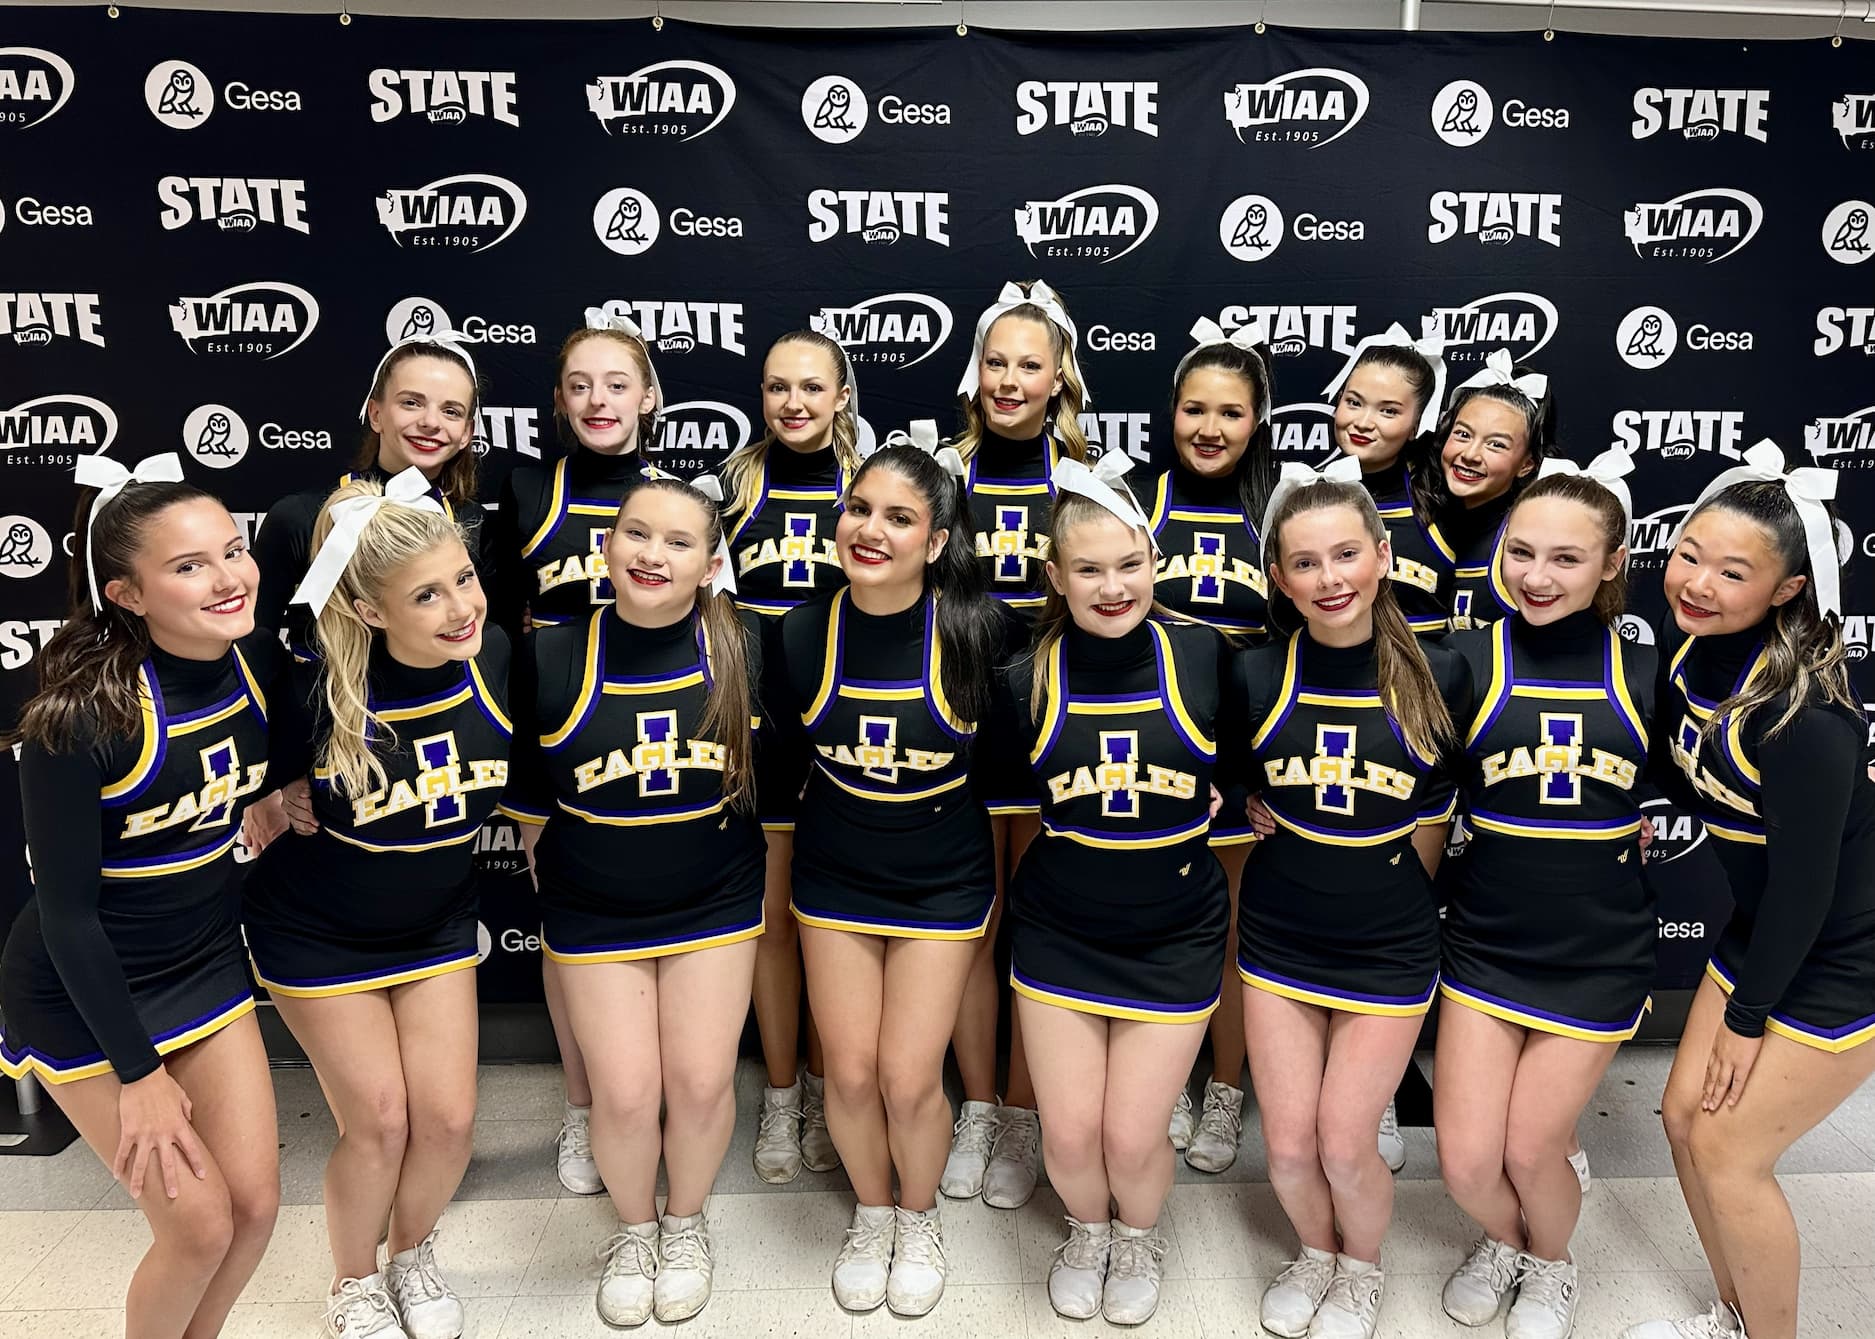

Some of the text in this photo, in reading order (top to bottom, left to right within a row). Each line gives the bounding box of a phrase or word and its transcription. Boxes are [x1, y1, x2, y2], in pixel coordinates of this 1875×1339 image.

[0, 70, 52, 100] AA
[225, 82, 301, 110] Gesa
[369, 69, 519, 127] STATE
[612, 81, 712, 114] WIAA
[878, 96, 950, 124] Gesa
[1017, 81, 1158, 137] STATE
[1248, 89, 1345, 120] WIAA
[1503, 100, 1569, 128] Gesa
[1632, 88, 1769, 143] STATE
[623, 124, 686, 134] Est.1905
[1256, 131, 1318, 141] Est.1905
[16, 197, 92, 225] Gesa
[158, 176, 309, 234] STATE
[400, 194, 504, 226] WIAA
[808, 190, 949, 247] STATE
[1429, 191, 1561, 247] STATE
[670, 208, 742, 237] Gesa
[1039, 206, 1136, 236] WIAA
[1294, 213, 1364, 240] Gesa
[1648, 208, 1739, 238] WIAA
[414, 236, 478, 246] Est.1905
[1048, 247, 1109, 256] Est.1905
[1654, 248, 1713, 257] Est.1905
[0, 293, 105, 348] TATE
[195, 303, 297, 332] WIAA
[463, 316, 536, 344] Gesa
[838, 312, 929, 343] WIAA
[1444, 313, 1535, 341] WIAA
[208, 343, 271, 353] Est.1905
[1087, 325, 1155, 351] Gesa
[1687, 324, 1753, 350] Gesa
[0, 415, 96, 444] WIAA
[259, 423, 331, 449] Gesa
[474, 407, 541, 460] ATE
[1081, 413, 1150, 463] ATE
[1272, 423, 1330, 450] IAA
[1611, 410, 1744, 461] STATE
[8, 455, 72, 464] Est.1905
[657, 459, 705, 470] t.1905
[1832, 458, 1875, 469] Est.19
[738, 536, 842, 578] EAGLE
[1632, 559, 1664, 569] Est.1
[537, 553, 609, 596] EAG
[1387, 556, 1439, 594] LES
[1263, 756, 1417, 801] EAGLES
[1481, 745, 1638, 791] EAGLES
[352, 759, 509, 828] EAGLES
[1047, 762, 1197, 805] EAGLES
[120, 759, 269, 839] EAGLE
[474, 826, 533, 851] IA
[1652, 815, 1692, 841] AA
[479, 861, 517, 870] .1905
[500, 929, 541, 952] Ge
[1657, 918, 1705, 939] esa
